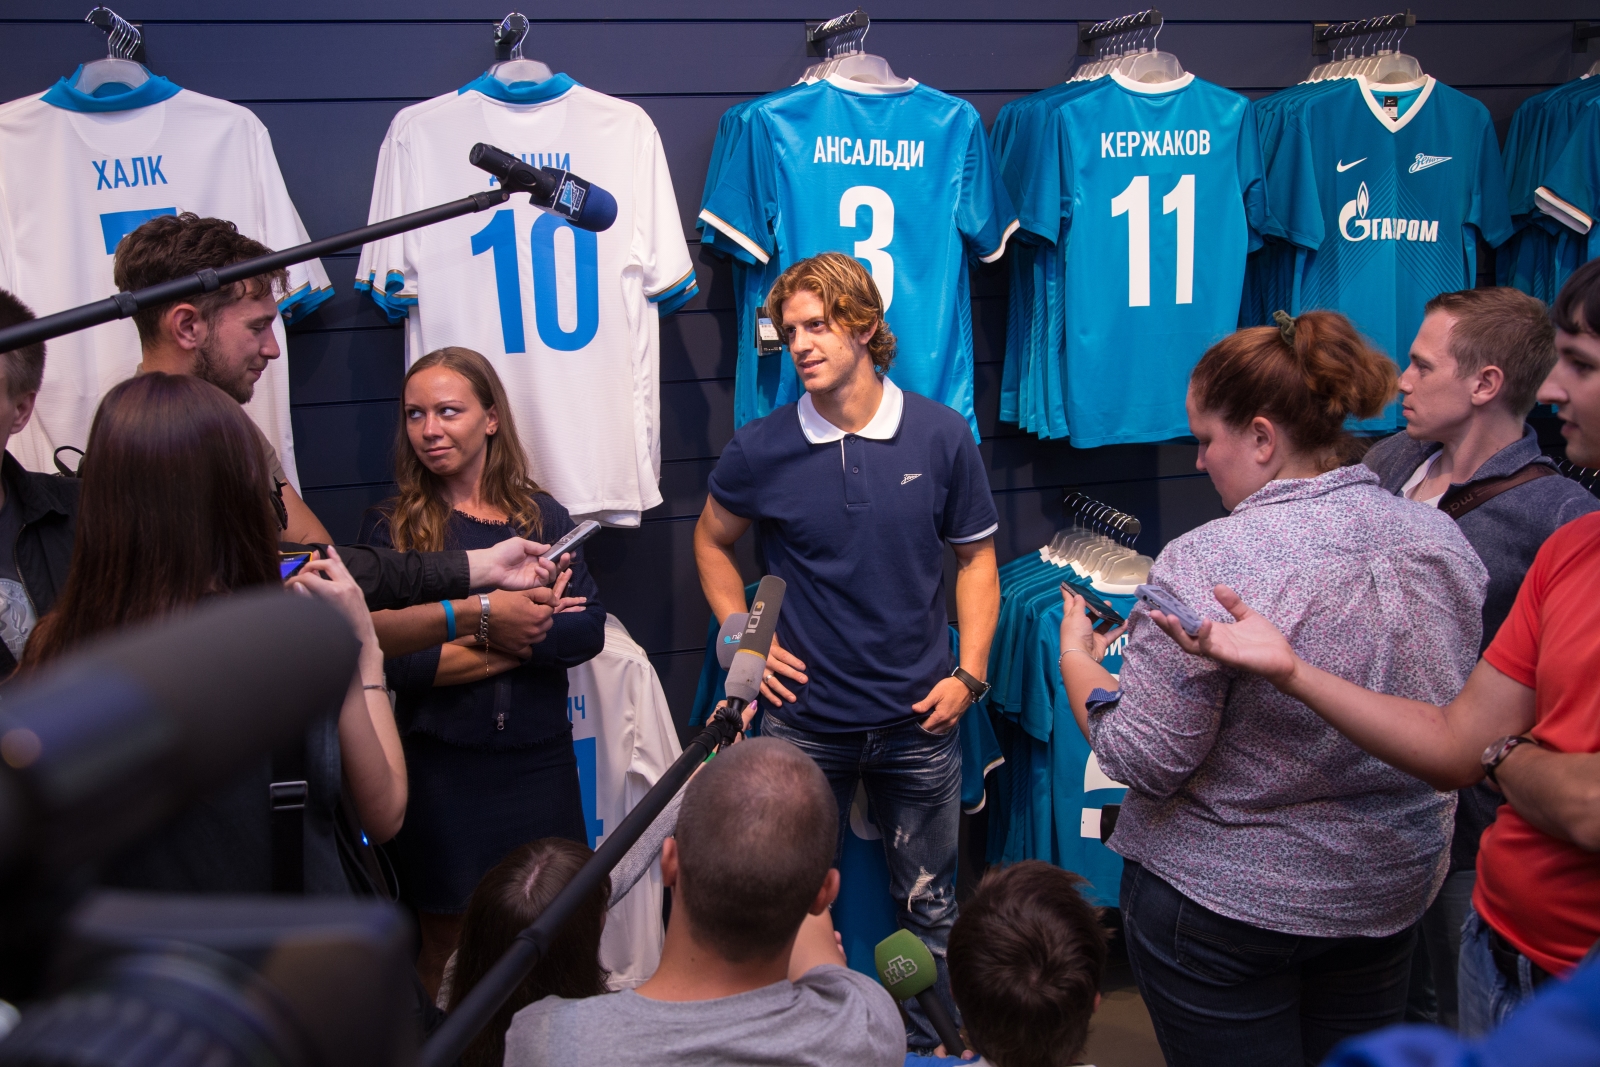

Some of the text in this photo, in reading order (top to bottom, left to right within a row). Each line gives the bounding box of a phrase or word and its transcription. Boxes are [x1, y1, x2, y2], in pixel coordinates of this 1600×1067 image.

[813, 136, 924, 171] АНСАЛЬДИ
[1101, 129, 1211, 158] КЕРЖАКОВ
[92, 155, 168, 190] ХАЛК
[1111, 174, 1195, 307] 11
[1371, 218, 1439, 242] ГАРОМ
[839, 185, 894, 314] 3
[471, 209, 599, 354] 10
[884, 955, 918, 986] НТВ
